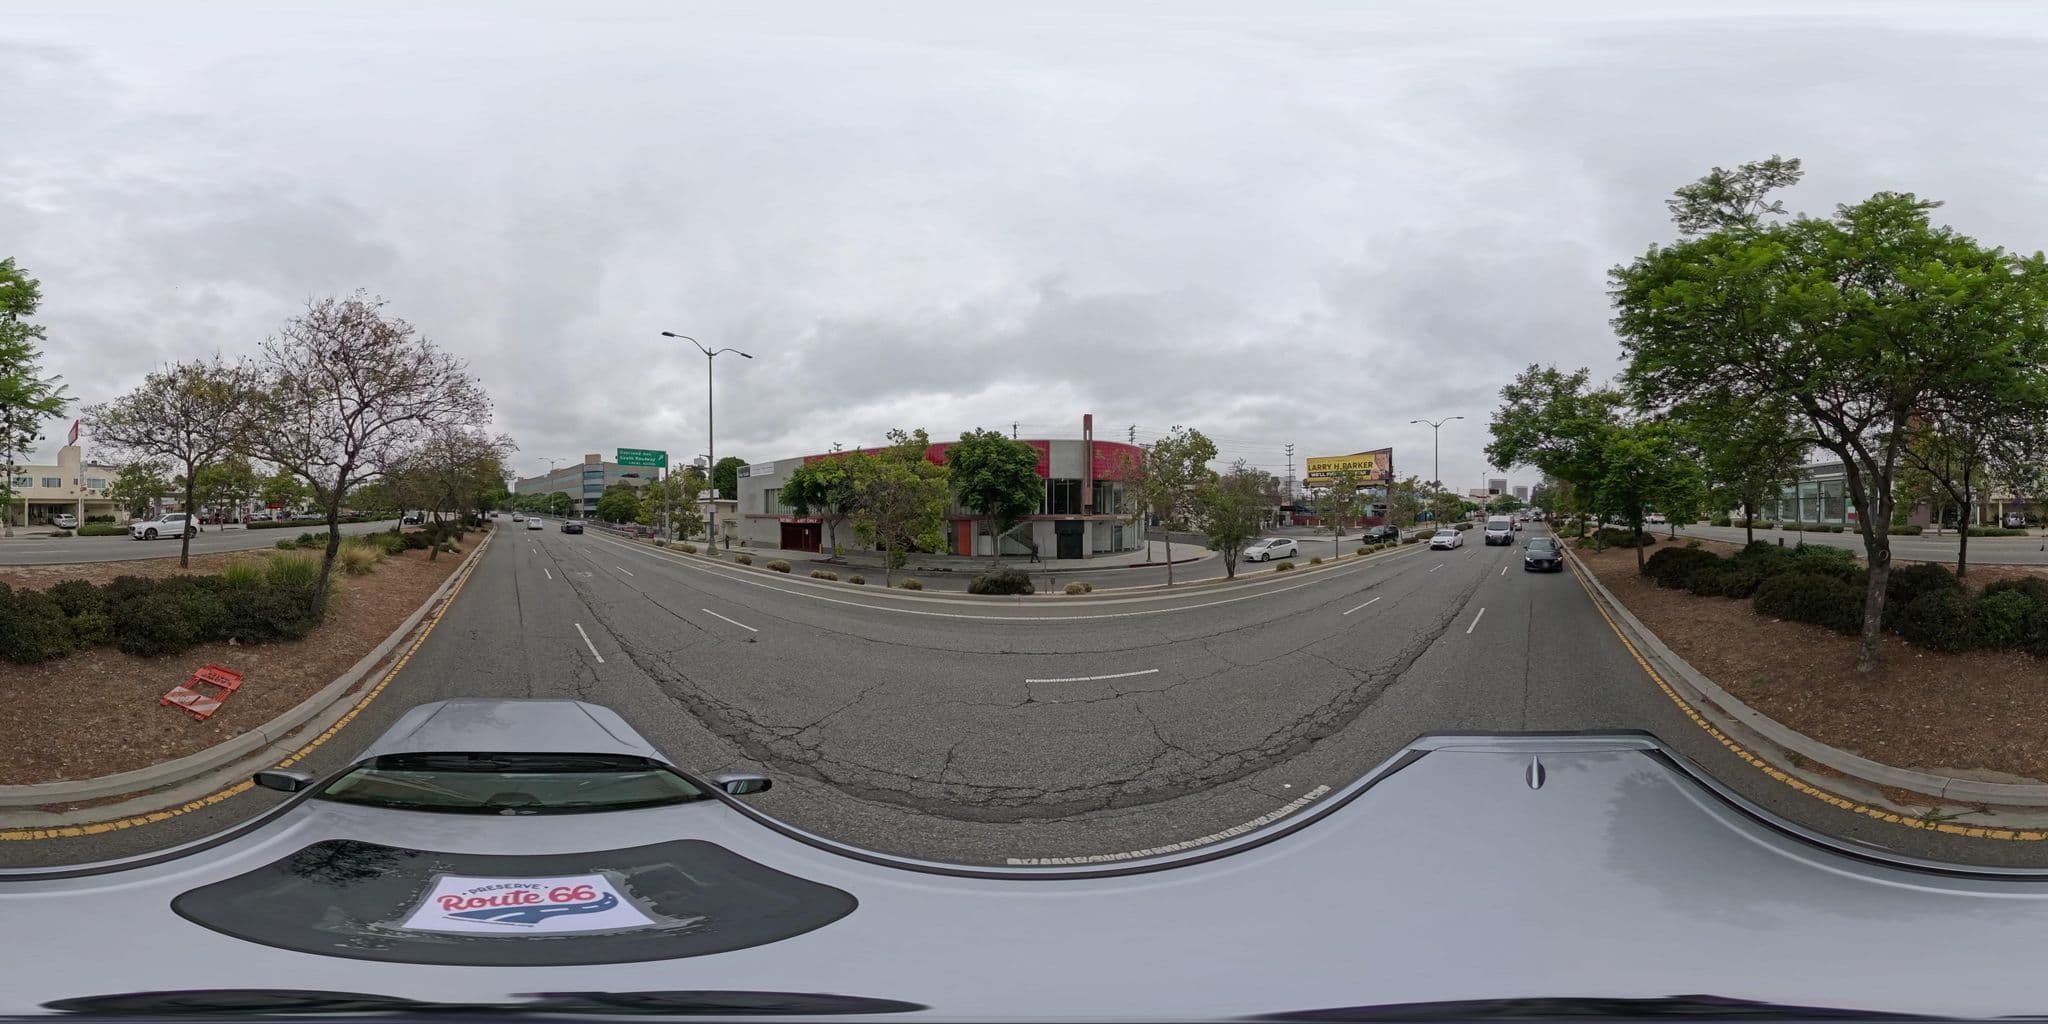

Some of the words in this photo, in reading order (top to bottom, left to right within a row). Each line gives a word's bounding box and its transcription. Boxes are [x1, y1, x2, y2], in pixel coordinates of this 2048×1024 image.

[1308, 463, 1332, 471] LARRY
[1342, 461, 1374, 470] PARKER
[469, 883, 543, 897] PRESERVE
[437, 889, 545, 911] Route
[548, 884, 597, 904] 66
